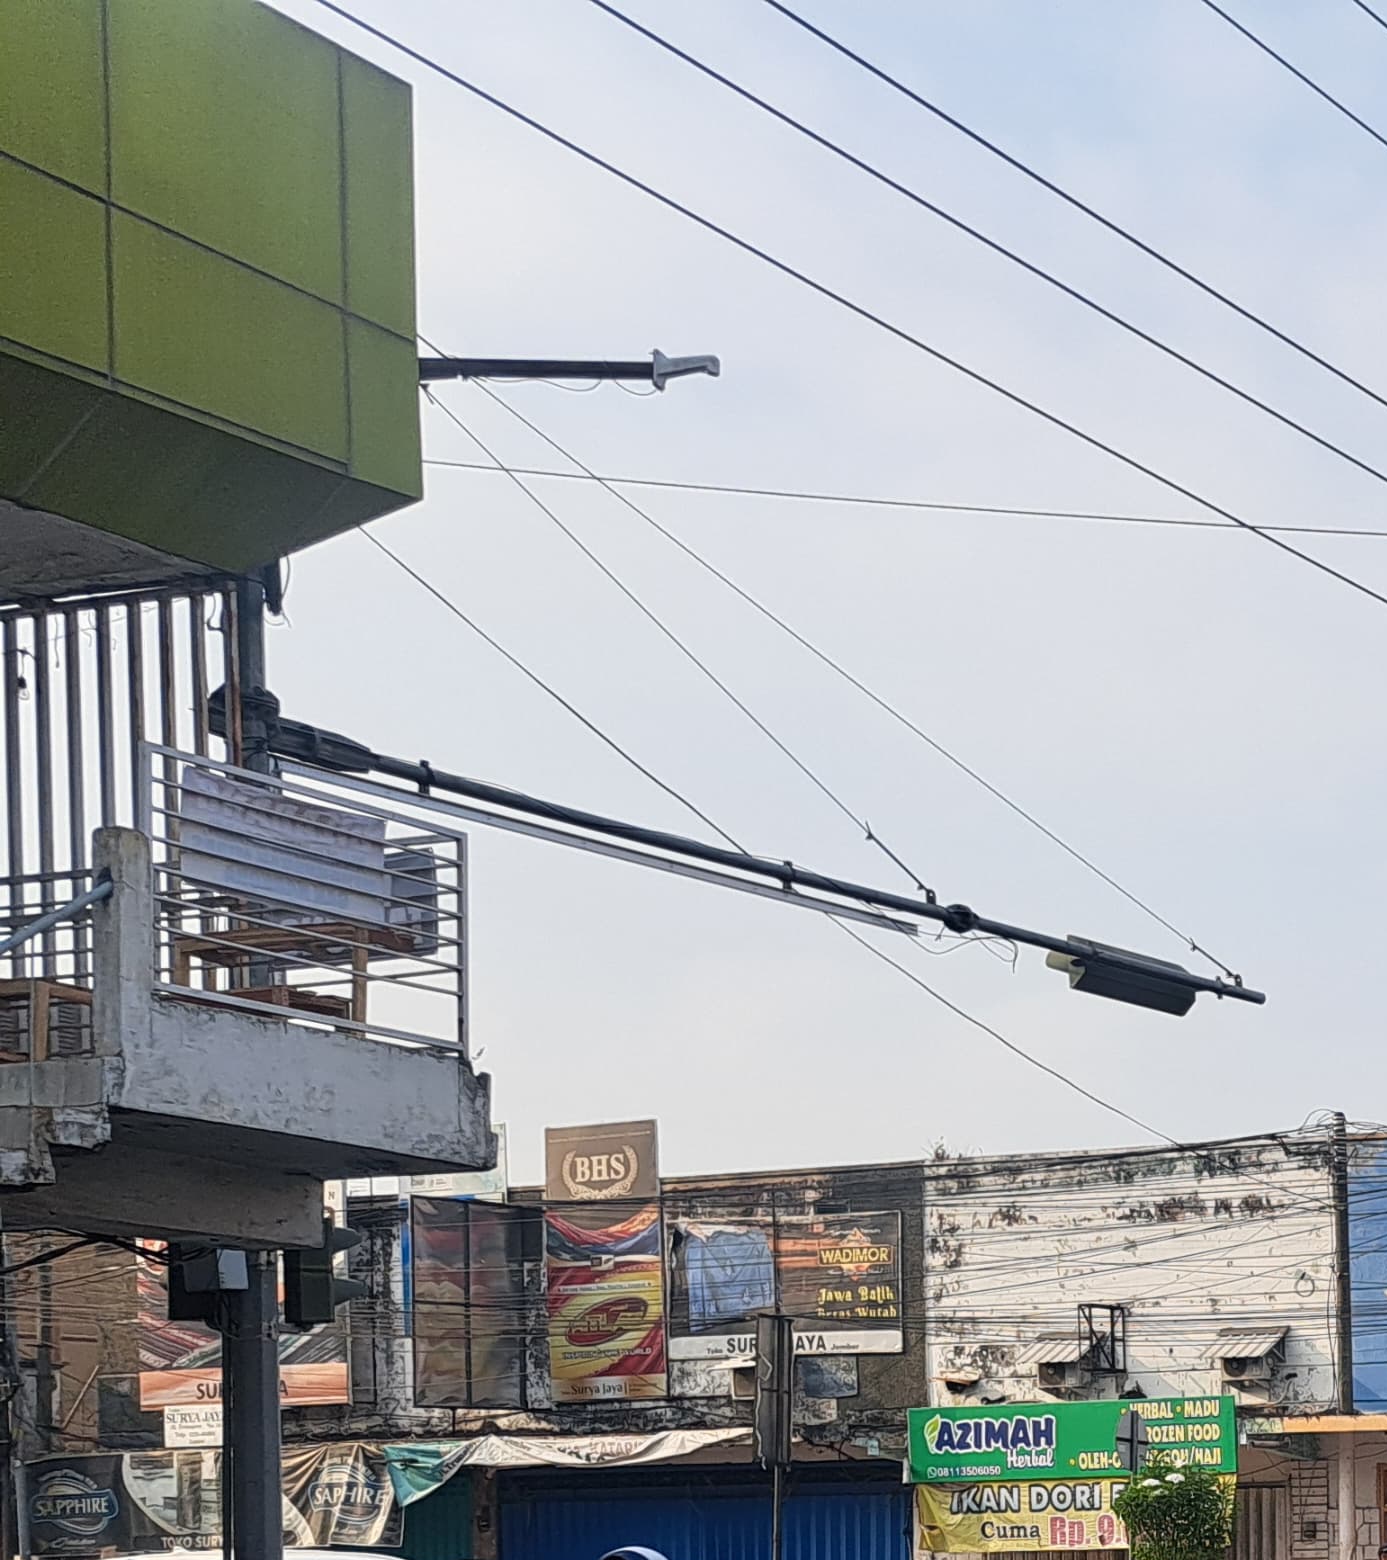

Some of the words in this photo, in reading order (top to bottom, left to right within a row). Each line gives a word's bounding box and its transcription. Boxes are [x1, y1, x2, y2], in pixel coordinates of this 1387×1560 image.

[574, 1153, 625, 1183] BHS
[820, 1248, 889, 1264] WADIMOR
[727, 1337, 757, 1354] SUR
[795, 1335, 827, 1351] AYA
[202, 1410, 222, 1423] JAY
[1184, 1400, 1220, 1416] MADU
[935, 1416, 1056, 1451] AZIMAH
[1147, 1425, 1184, 1443] ROZEN
[1188, 1423, 1221, 1441] FOOD
[1007, 1447, 1054, 1468] Herbal
[950, 1485, 1021, 1514] IKAN
[1029, 1483, 1102, 1513] DORI
[981, 1521, 1041, 1539] Cuma
[161, 1536, 192, 1548] TOKO
